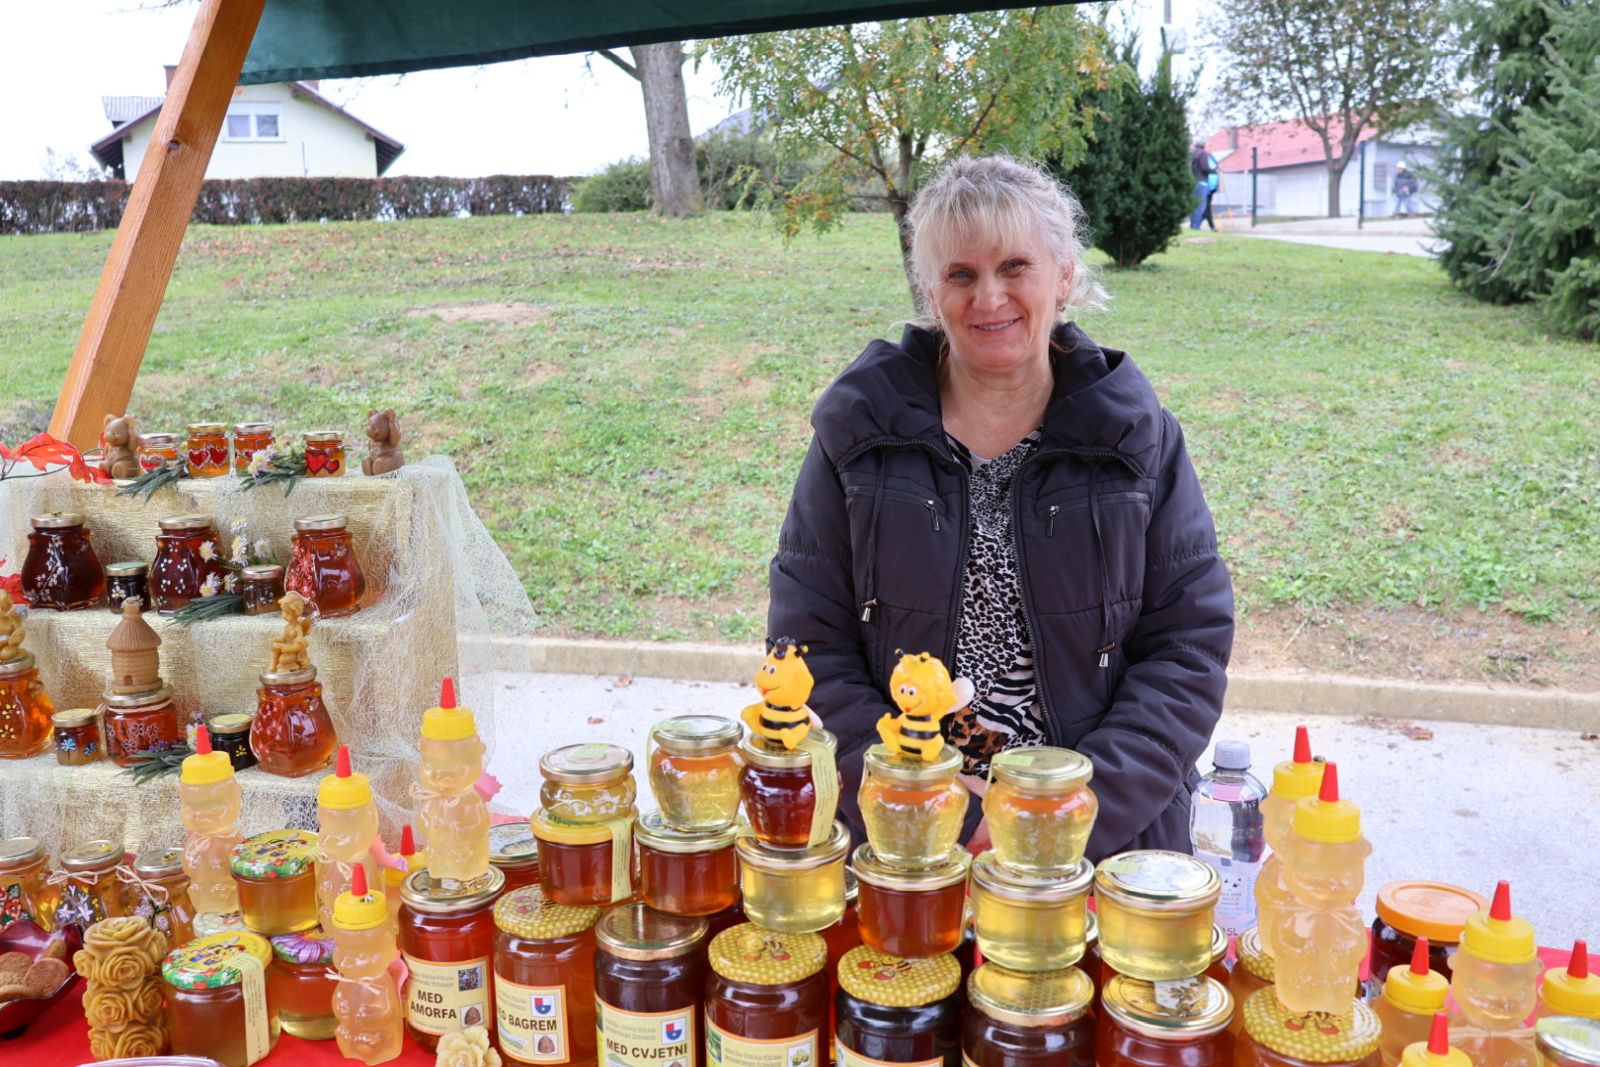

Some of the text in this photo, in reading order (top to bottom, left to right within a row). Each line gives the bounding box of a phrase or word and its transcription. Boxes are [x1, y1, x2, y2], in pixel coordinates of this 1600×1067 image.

[417, 989, 443, 1004] MED
[410, 1001, 457, 1019] AMORFA
[498, 1007, 557, 1031] ED BAGREM
[606, 1038, 688, 1059] MED CVJETNI
